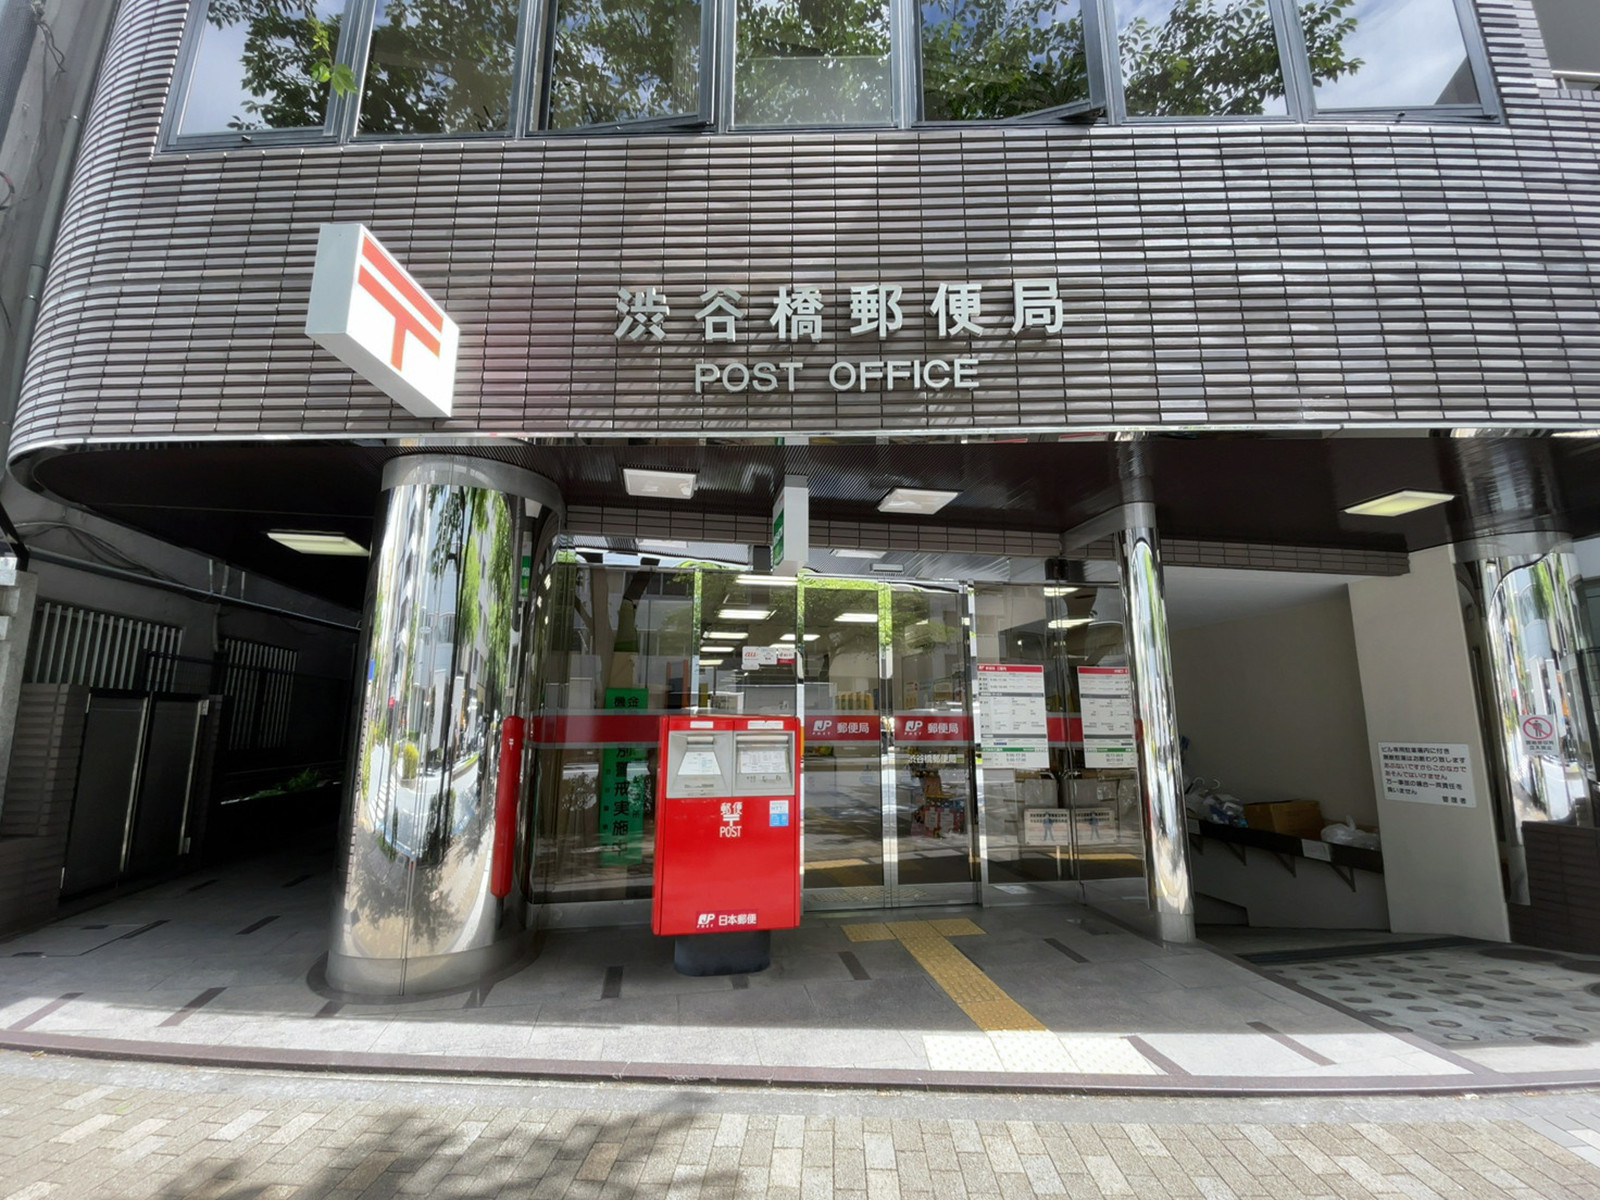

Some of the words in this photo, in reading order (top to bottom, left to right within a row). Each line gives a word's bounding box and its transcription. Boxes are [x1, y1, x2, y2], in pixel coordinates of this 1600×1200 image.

[613, 278, 1065, 343] 渋谷橋郵便局
[694, 362, 804, 393] POST
[828, 359, 981, 393] OFFICE
[836, 722, 869, 734] 郵便局
[927, 722, 959, 734] 郵便局
[909, 754, 957, 763] 渋谷橋郵便局
[1385, 770, 1448, 780] あそんではいけません
[720, 802, 742, 815] 郵便
[719, 826, 742, 838] POST
[718, 913, 757, 926] 日本郵便
